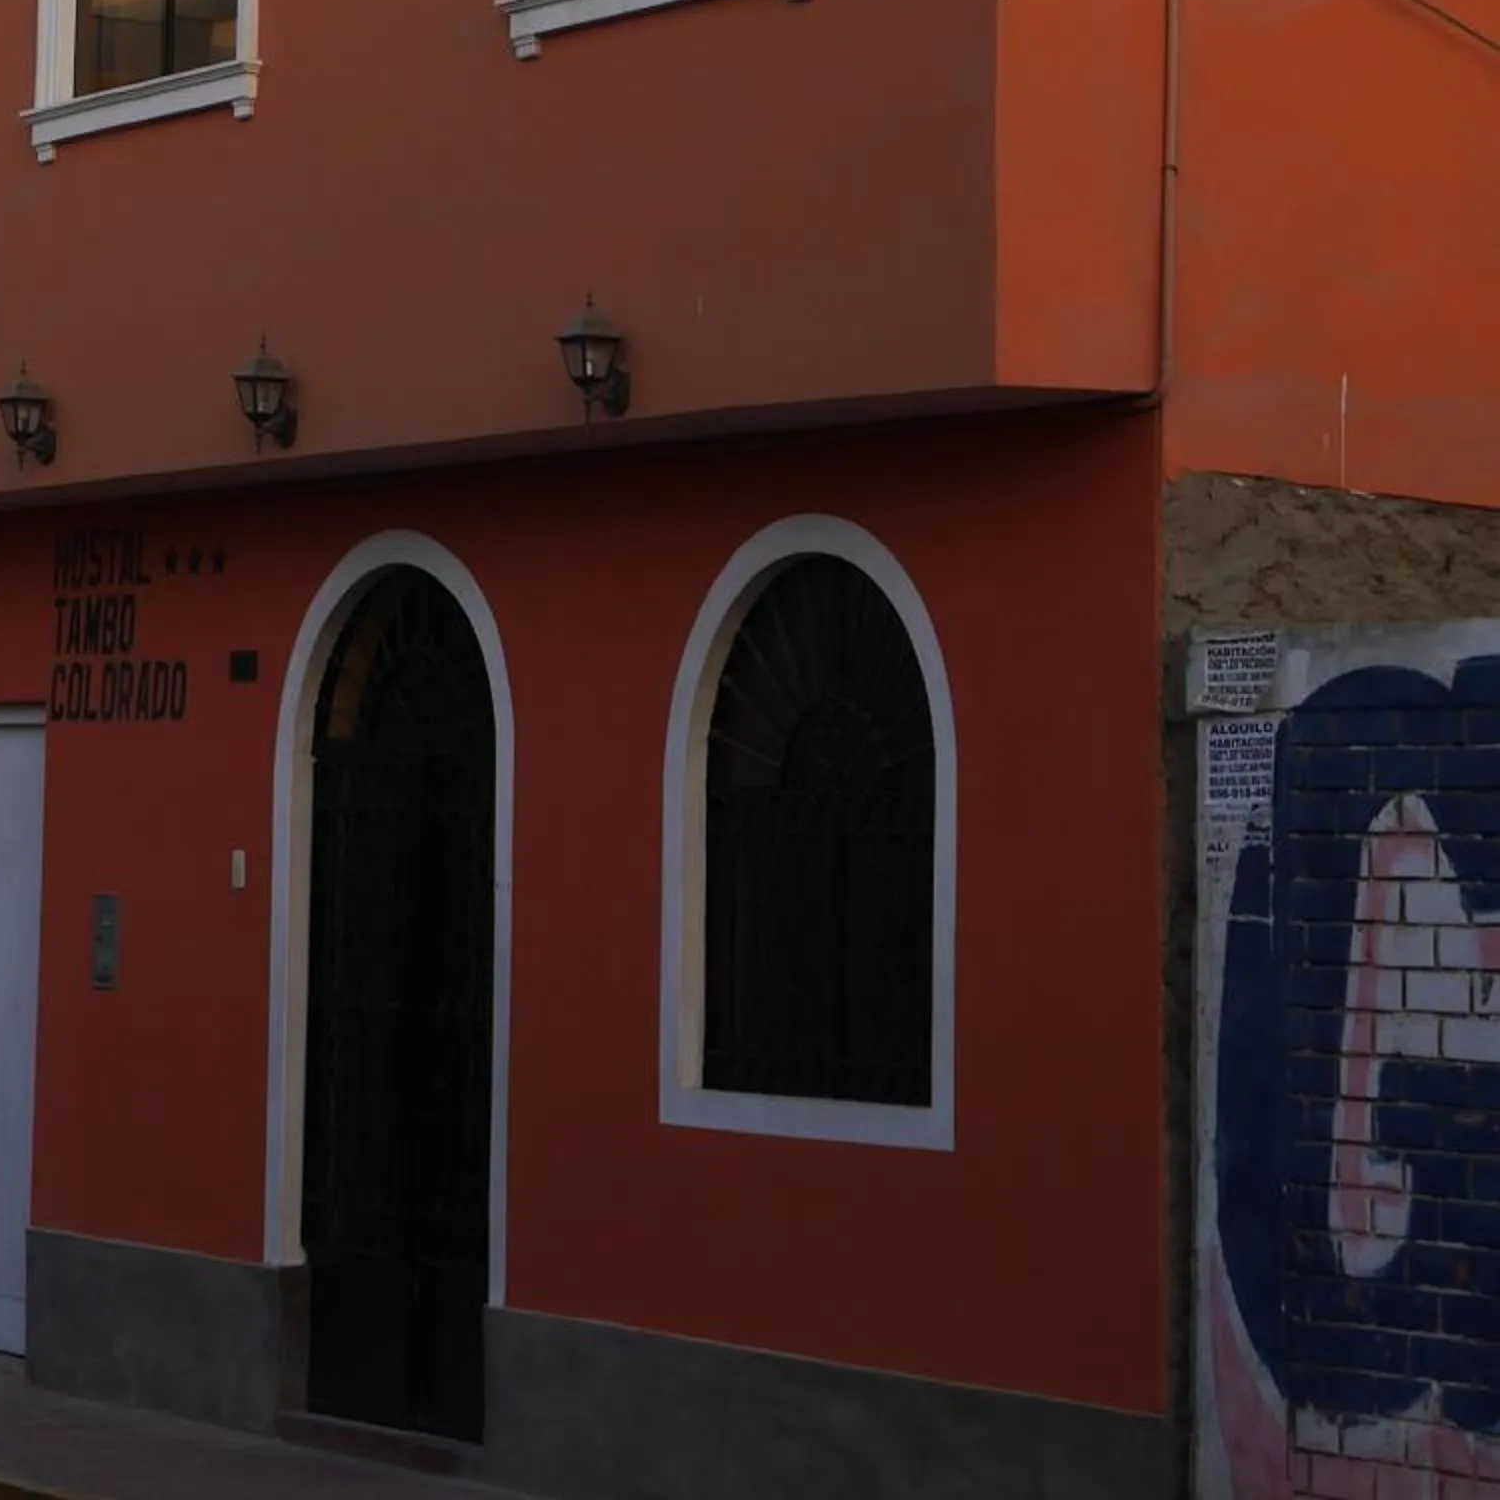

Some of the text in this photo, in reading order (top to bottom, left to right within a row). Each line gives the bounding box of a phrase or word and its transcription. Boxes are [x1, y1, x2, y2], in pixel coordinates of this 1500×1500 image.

[53, 528, 150, 588] HOSTAL
[54, 594, 136, 655] TAMBO
[51, 660, 187, 722] COLORADO
[1210, 722, 1273, 735] ALQUILO
